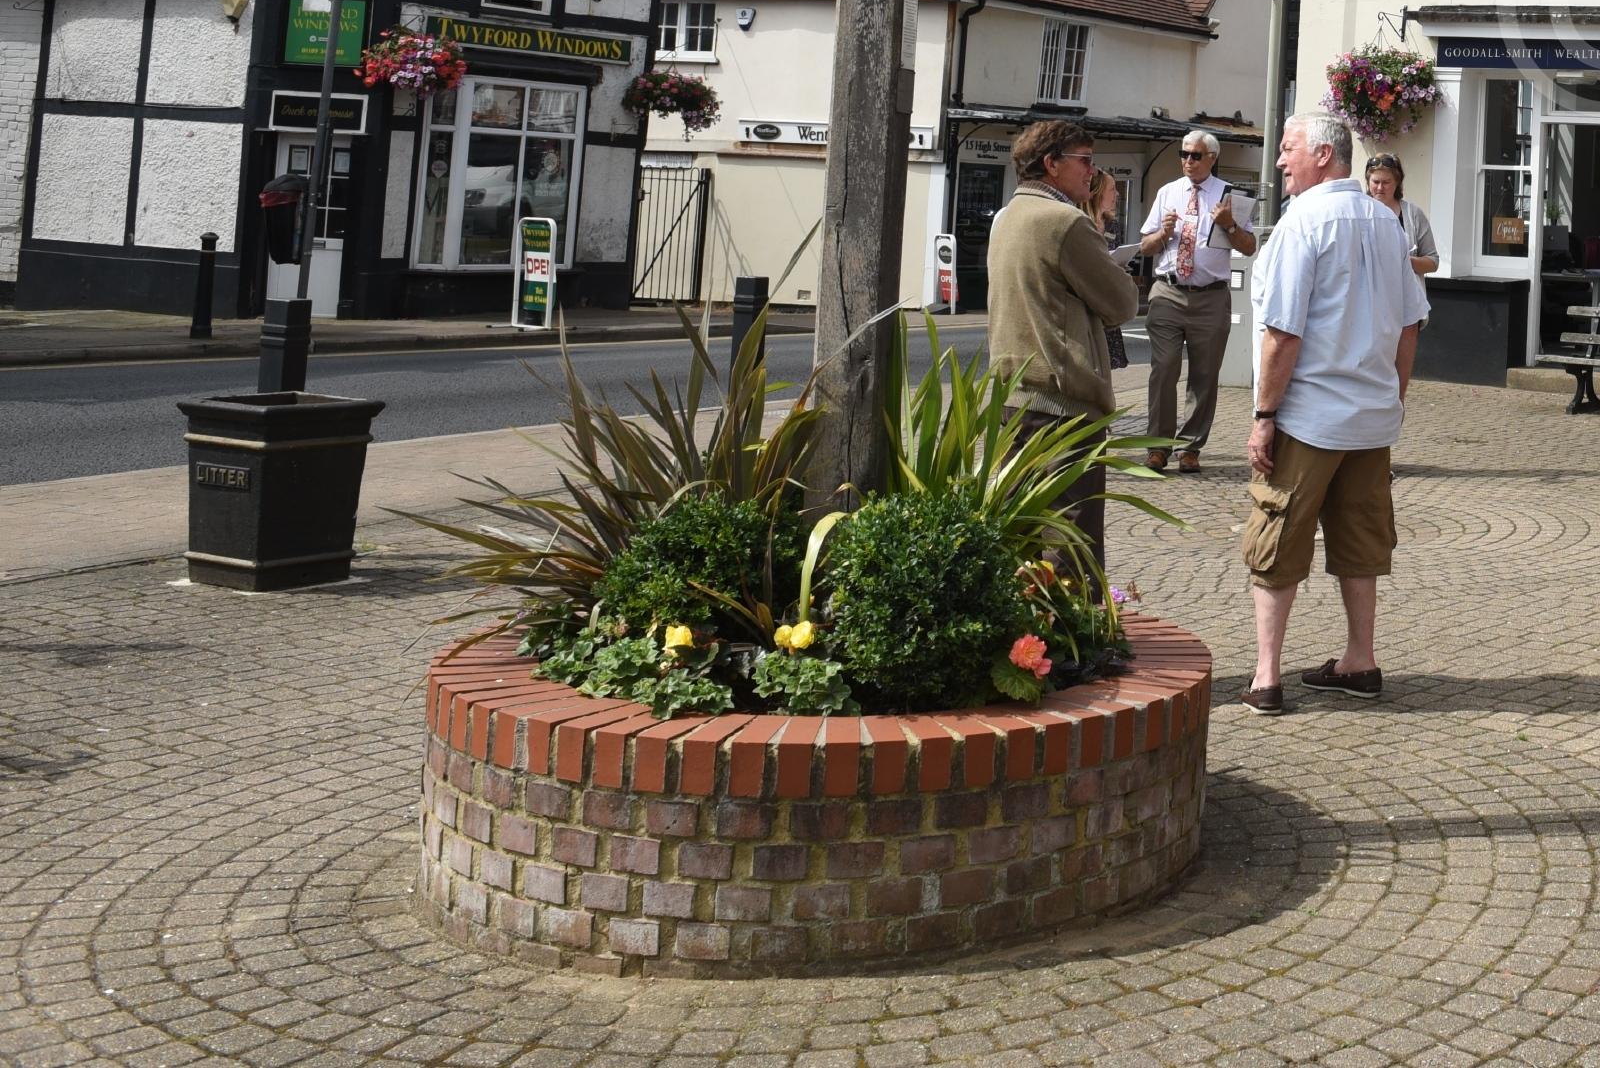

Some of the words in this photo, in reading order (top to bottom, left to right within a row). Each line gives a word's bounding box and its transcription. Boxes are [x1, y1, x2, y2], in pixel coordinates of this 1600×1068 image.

[293, 19, 359, 33] WINDWS
[1444, 47, 1543, 59] GOODALL-SMITH
[975, 140, 992, 153] High
[993, 141, 1011, 152] Street
[196, 465, 246, 486] LITTER
